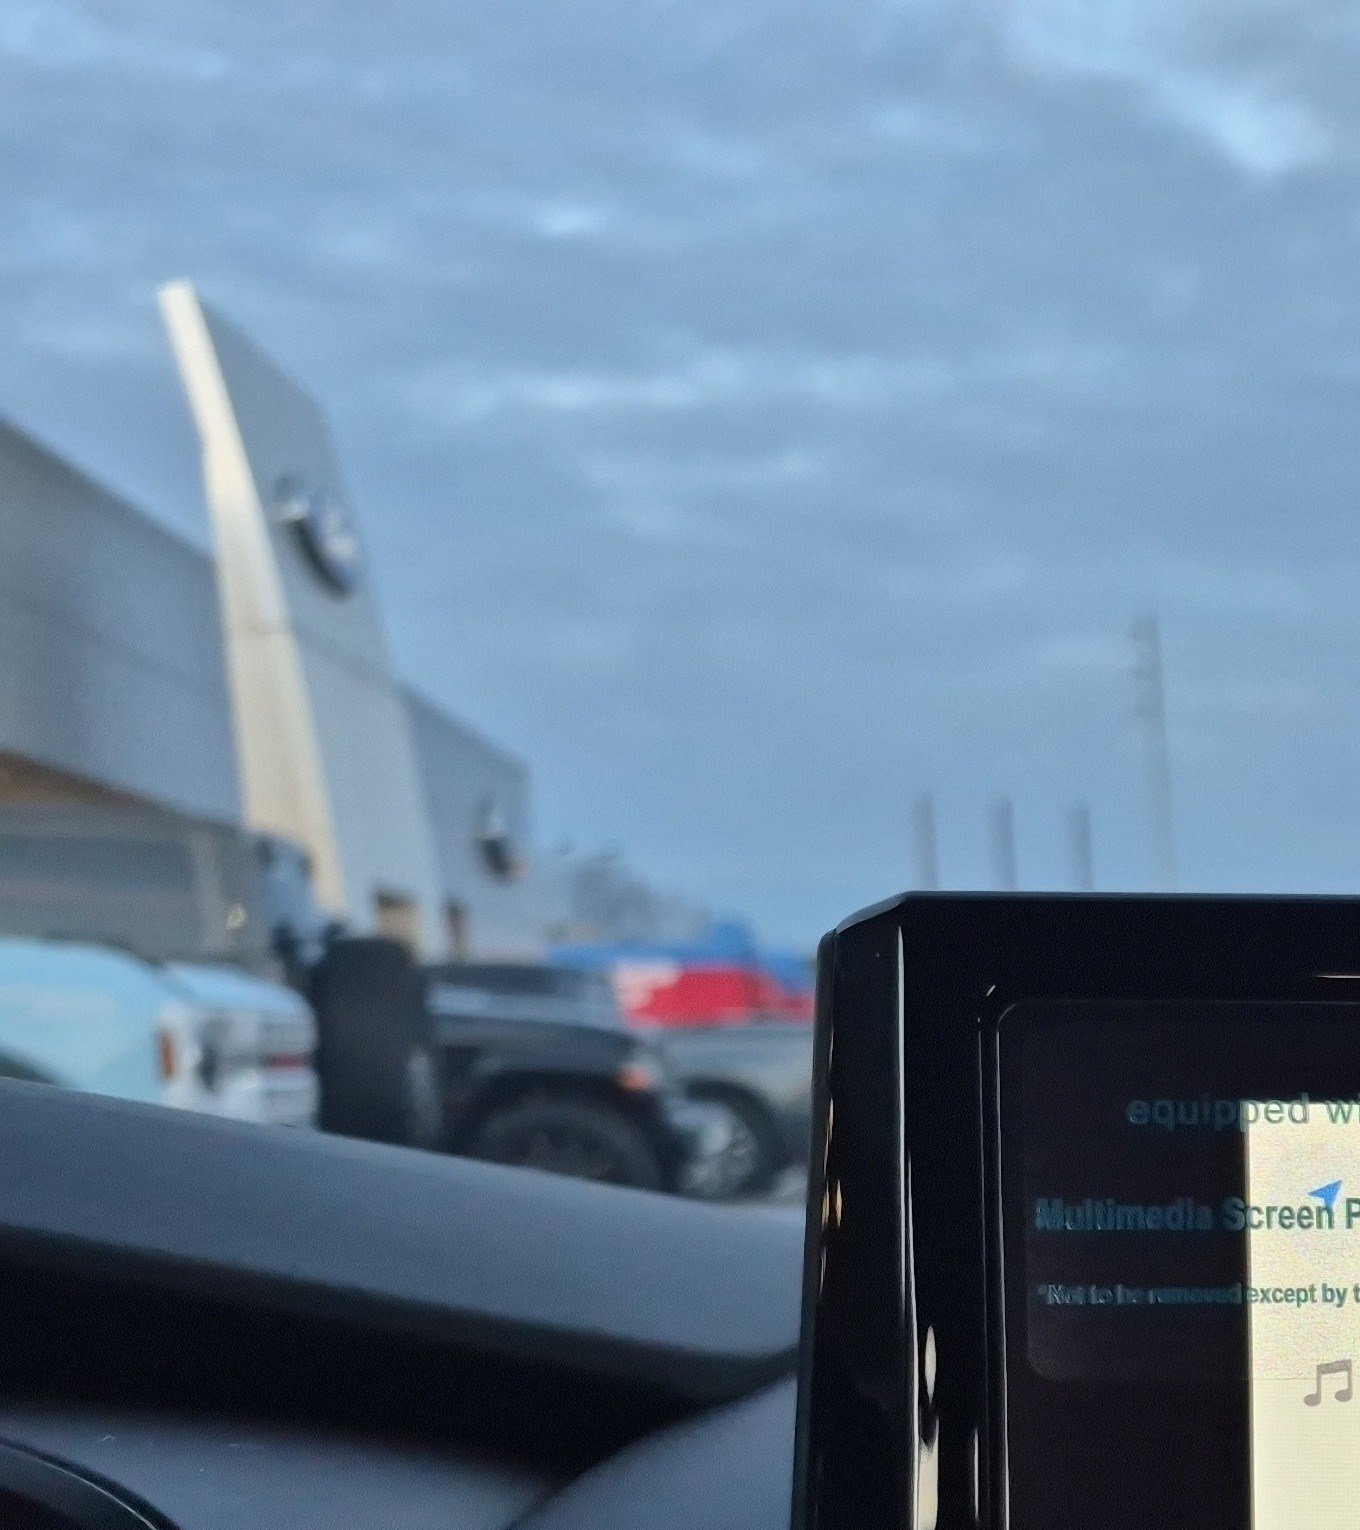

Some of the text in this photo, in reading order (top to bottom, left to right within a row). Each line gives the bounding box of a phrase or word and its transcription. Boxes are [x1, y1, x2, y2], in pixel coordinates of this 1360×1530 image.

[1129, 1093, 1309, 1132] equipped
[1223, 1197, 1335, 1231] Screen
[1249, 1284, 1318, 1308] except
[1321, 1283, 1348, 1308] by
